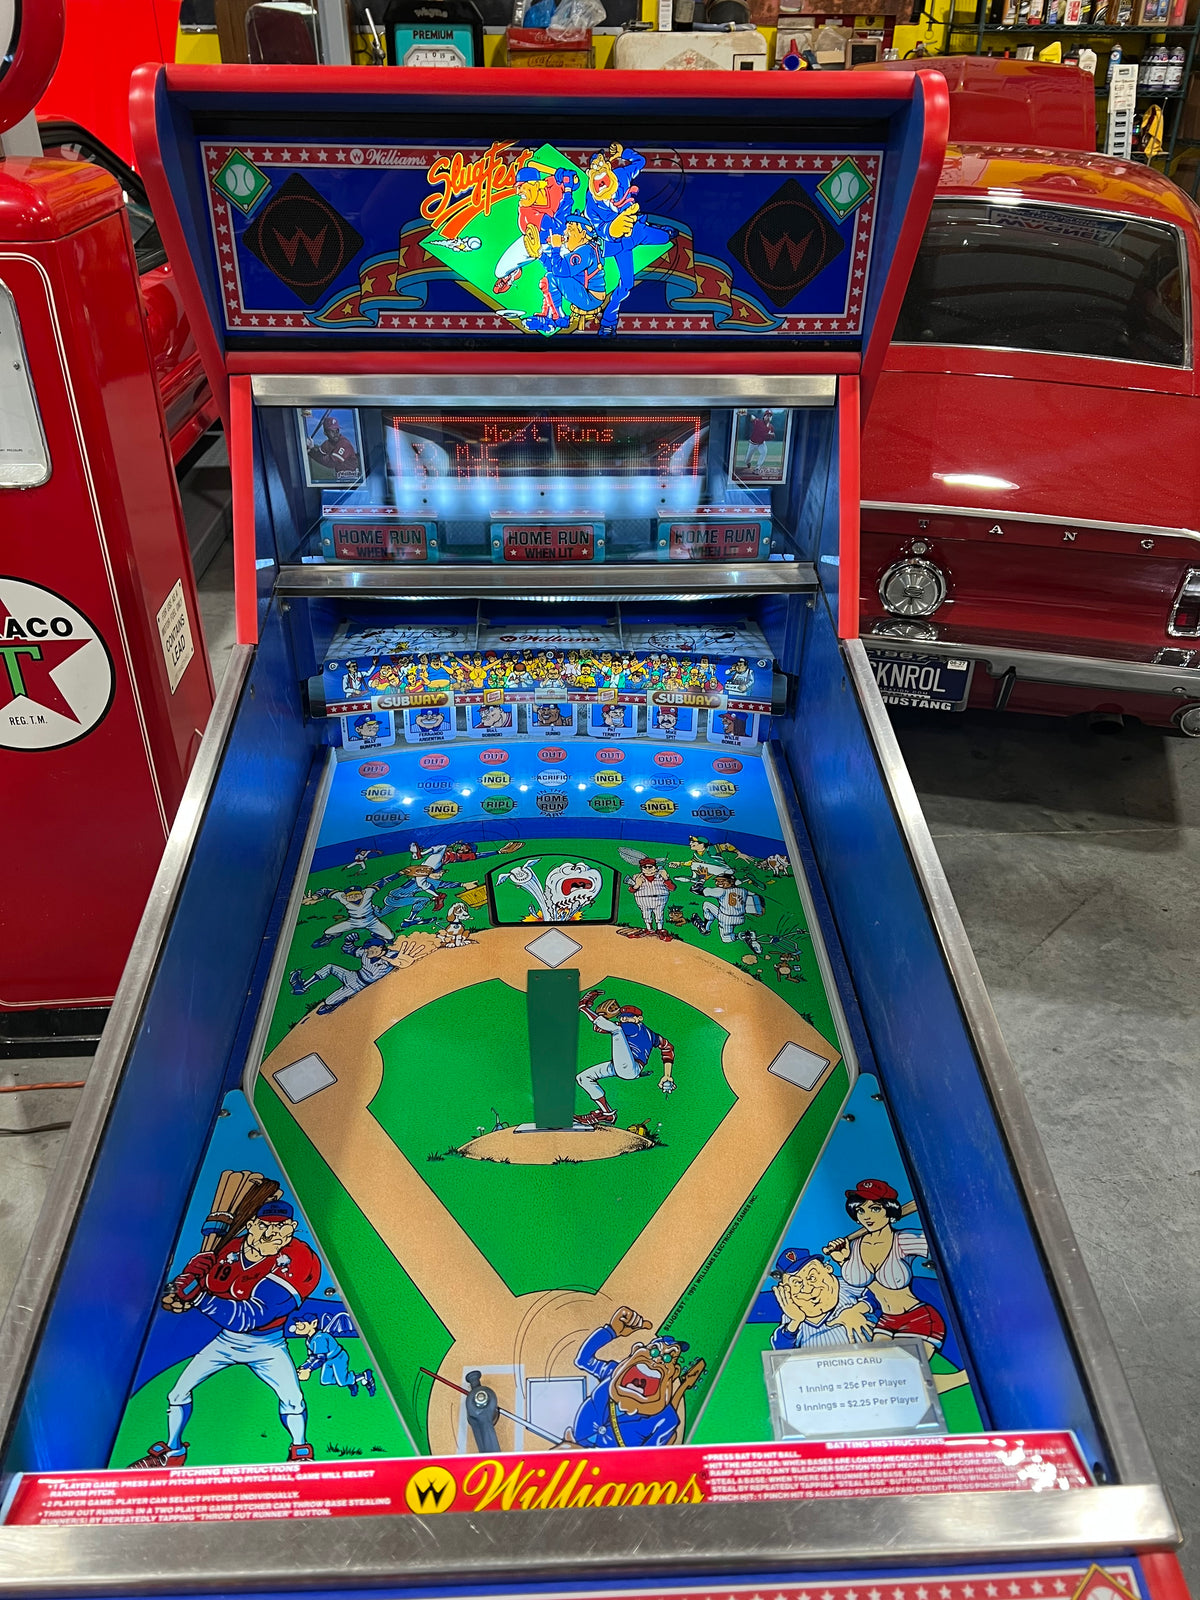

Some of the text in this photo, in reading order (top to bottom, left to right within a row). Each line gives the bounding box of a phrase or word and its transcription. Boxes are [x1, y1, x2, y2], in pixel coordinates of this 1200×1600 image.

[412, 30, 454, 40] PREMIUM
[366, 148, 427, 166] Williams
[484, 424, 614, 442] Most Runs
[338, 530, 421, 545] HOME RUN
[508, 530, 590, 546] HOME RUN
[675, 528, 756, 544] HOME RUN
[357, 547, 388, 558] WHEN
[525, 548, 574, 559] WHEN LIT
[690, 545, 739, 557] WHEN LIT
[0, 617, 73, 638] ACO
[166, 614, 185, 652] CONTAINS
[171, 634, 186, 667] LEAD
[381, 693, 446, 708] SUBWAY
[655, 693, 719, 706] SUBWAY
[9, 715, 48, 726] REG. T.M.
[483, 752, 505, 760] OUT
[541, 751, 564, 759] OUT
[658, 755, 679, 763] OUT
[423, 758, 445, 766] OUT
[363, 765, 386, 773] OUT
[361, 789, 401, 797] SINGL
[704, 784, 740, 792] INGLE
[423, 805, 464, 813] SINGLE
[587, 799, 625, 807] TRIPLE
[640, 803, 679, 811] SINGLE
[365, 813, 411, 822] DOUBLE
[692, 809, 736, 817] DOUBLE
[213, 1265, 232, 1281] 19
[663, 1301, 686, 1332] SLUGFEST
[687, 1284, 698, 1296] 1991
[696, 1256, 716, 1284] WILLIAMS
[713, 1222, 740, 1259] ELECTRONICS
[737, 1204, 752, 1223] GAMES
[817, 1357, 883, 1369] PRICING CARD
[806, 1384, 834, 1393] Inning
[861, 1380, 876, 1388] Per
[879, 1379, 907, 1389] Player
[795, 1404, 802, 1412] 9
[804, 1402, 838, 1412] Innings
[847, 1399, 871, 1408] $2.25
[873, 1398, 888, 1406] Per
[890, 1396, 919, 1406] Player
[826, 1438, 945, 1450] BATTING INSTRUCTIONS
[170, 1465, 300, 1477] PITCHING INSTRUCTIONS
[59, 1482, 92, 1490] PLAYER
[93, 1481, 119, 1489] GAME:
[120, 1480, 148, 1488] PRESS
[149, 1479, 167, 1487] ANY
[168, 1478, 194, 1486] PITCH
[195, 1477, 230, 1485] BUTTON
[245, 1475, 270, 1483] PITCH
[271, 1474, 295, 1482] BALL,
[321, 1471, 341, 1479] WILL
[342, 1470, 376, 1478] SELECT
[463, 1458, 705, 1512] Williams
[50, 1489, 117, 1498] RANDOM PITCH.
[53, 1499, 87, 1508] PLAYER
[116, 1497, 148, 1506] PLAYER
[149, 1496, 168, 1504] CAN
[202, 1494, 239, 1502] PITCHES
[239, 1491, 300, 1500] INDIVIDUALLY.
[43, 1509, 75, 1517] THROW
[96, 1508, 134, 1516] RUNNER:
[154, 1506, 174, 1514] TWO
[174, 1505, 207, 1513] PLAYER
[208, 1504, 233, 1512] GAME
[234, 1503, 272, 1511] PITCHER
[293, 1501, 324, 1509] THROW
[324, 1499, 347, 1507] BASE
[348, 1497, 392, 1506] STEALING
[158, 1514, 195, 1522] TAPPING
[294, 1508, 332, 1517] BUTTON.
